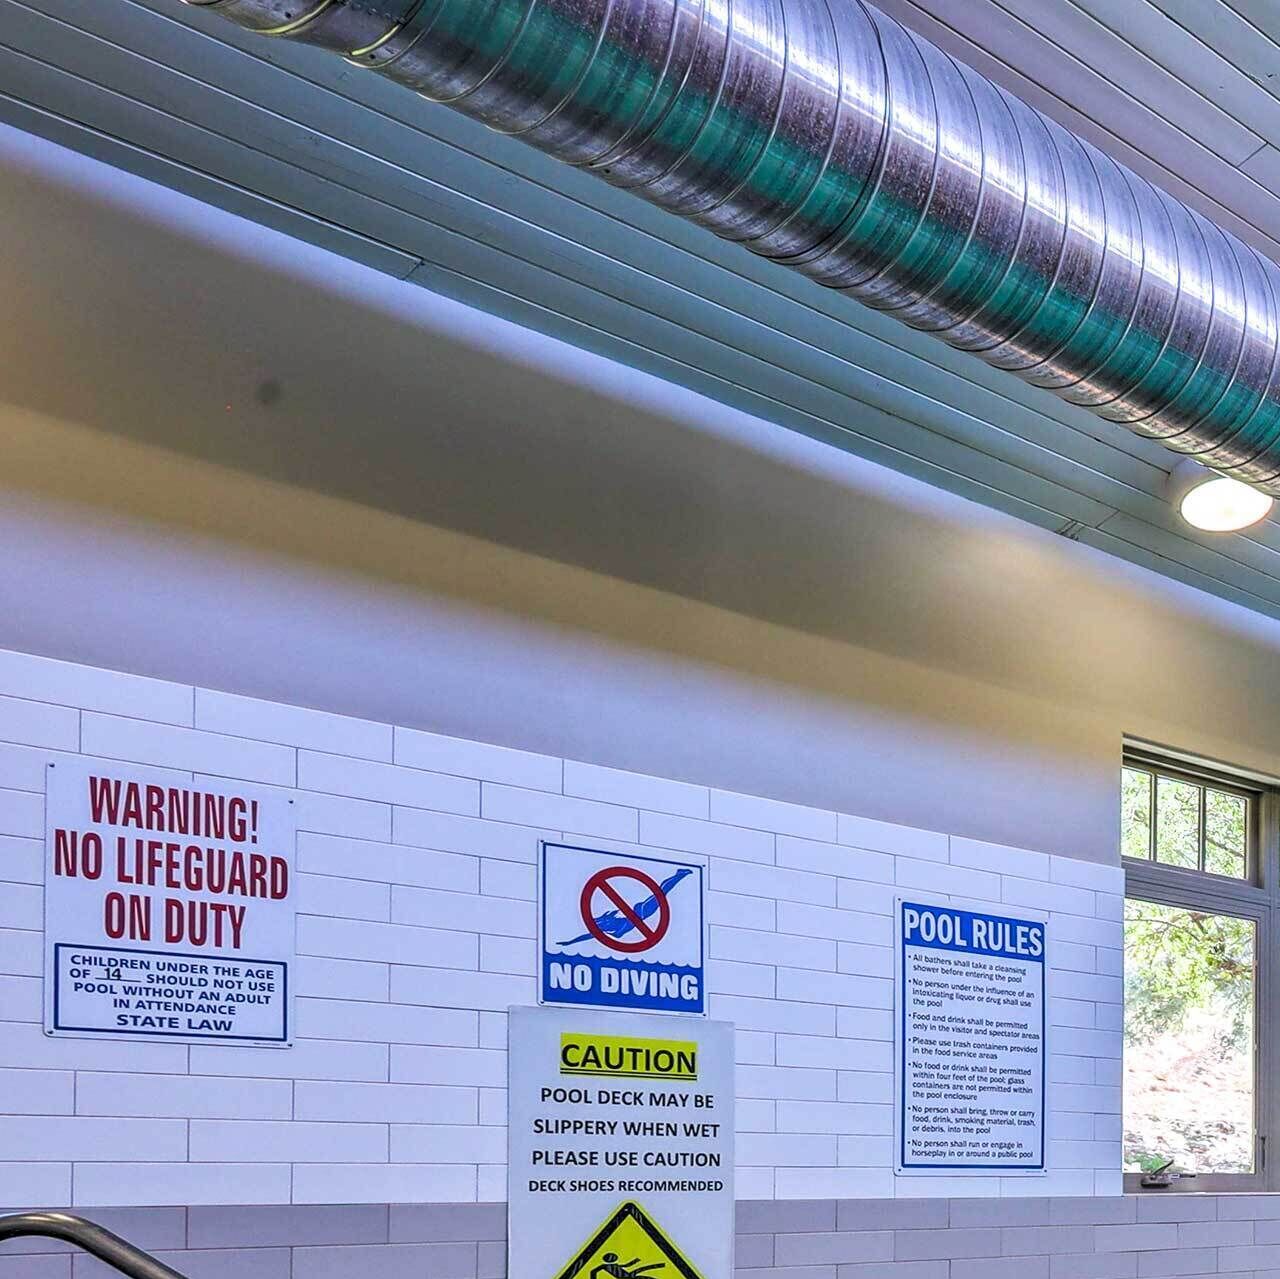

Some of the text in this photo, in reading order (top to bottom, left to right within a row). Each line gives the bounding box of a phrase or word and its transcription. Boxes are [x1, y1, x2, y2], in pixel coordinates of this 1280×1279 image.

[90, 776, 257, 844] WARNING!
[55, 829, 288, 900] NO LIFEGUARD
[105, 892, 246, 949] ON DUTY
[904, 909, 1042, 956] POOL RULES
[71, 955, 274, 979] CHILDREN UNDER THE AGE
[70, 968, 275, 992] OF 14 SHOULD NOT USE
[550, 962, 698, 1000] NO DIVING
[74, 982, 271, 1004] POOL WITHOUT AN ADULT
[114, 999, 236, 1015] IN ATTENDANCE
[117, 1014, 232, 1032] STATE LAW
[913, 1012, 930, 1020] Food
[948, 1016, 965, 1024] drink
[996, 1021, 1028, 1029] permitted
[913, 1023, 927, 1031] only
[952, 1026, 972, 1034] visitor
[989, 1030, 1020, 1038] spectator
[912, 1037, 937, 1045] Please
[973, 1043, 1008, 1051] containers
[1010, 1045, 1038, 1053] provided
[934, 1048, 950, 1056] food
[561, 1044, 696, 1073] CAUTION
[999, 1068, 1031, 1076] permitted
[541, 1088, 714, 1108] POOL DECK MAY BE
[955, 1117, 984, 1126] smoking
[1019, 1110, 1034, 1118] carry
[534, 1119, 720, 1137] SLIPPERY WHEN WET
[533, 1151, 721, 1166] PLEASE USE CAUTION
[912, 1149, 946, 1158] horseplay
[966, 1150, 990, 1158] around
[998, 1150, 1017, 1158] public
[529, 1181, 723, 1191] DECK SHOES RECOMMENDED
